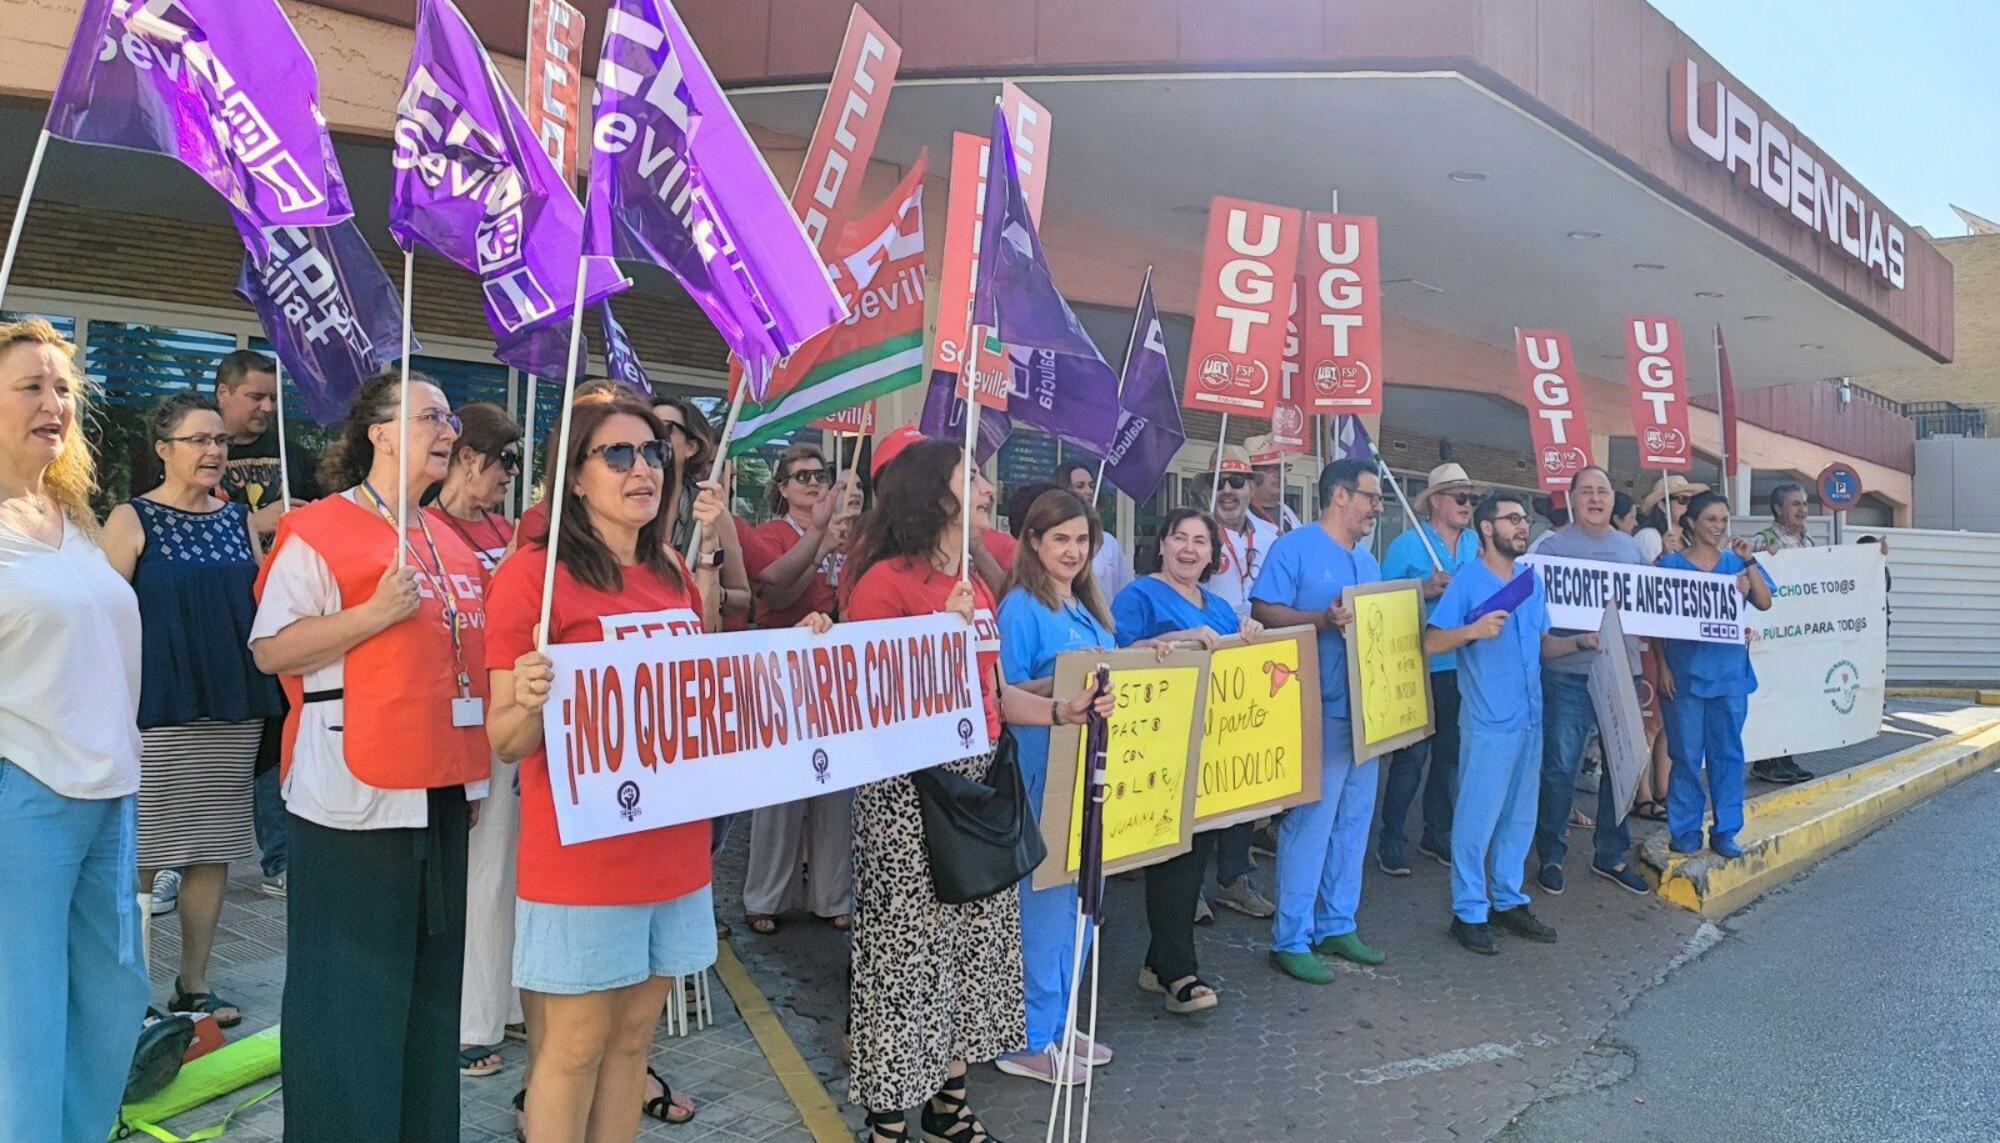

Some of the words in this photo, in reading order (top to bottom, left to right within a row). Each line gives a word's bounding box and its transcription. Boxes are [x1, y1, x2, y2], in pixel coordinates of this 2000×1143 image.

[541, 0, 571, 178] CCO
[1687, 58, 1905, 290] URGENCIAS
[1216, 208, 1282, 355] UGT
[1318, 222, 1363, 358] UGT
[1203, 359, 1229, 377] UGT
[1235, 364, 1255, 377] FSP
[1317, 366, 1337, 381] UGT
[1342, 367, 1358, 377] FSP
[1525, 336, 1574, 445] UGT
[1633, 320, 1676, 425] UGT
[825, 404, 873, 428] evilla
[1544, 564, 1609, 609] RECORTE
[1613, 572, 1632, 611] DE
[1636, 574, 1738, 622] ANESTESISTAS
[1803, 582, 1819, 595] DE
[1820, 579, 1856, 595] TOD@S
[1701, 622, 1739, 640] CCOO
[1804, 621, 1835, 635] PARA
[1837, 617, 1867, 633] TOD@S
[1117, 680, 1170, 709] STOP
[1211, 666, 1245, 704] NO
[563, 665, 625, 806] ¡NO
[634, 651, 788, 775] QUEREMOS
[787, 644, 863, 741] PARIR
[865, 638, 906, 729] CON
[908, 630, 972, 720] DOLOR!
[1111, 717, 1161, 740] PARTO
[1218, 699, 1270, 746] parto
[1232, 746, 1287, 791] DOLOR
